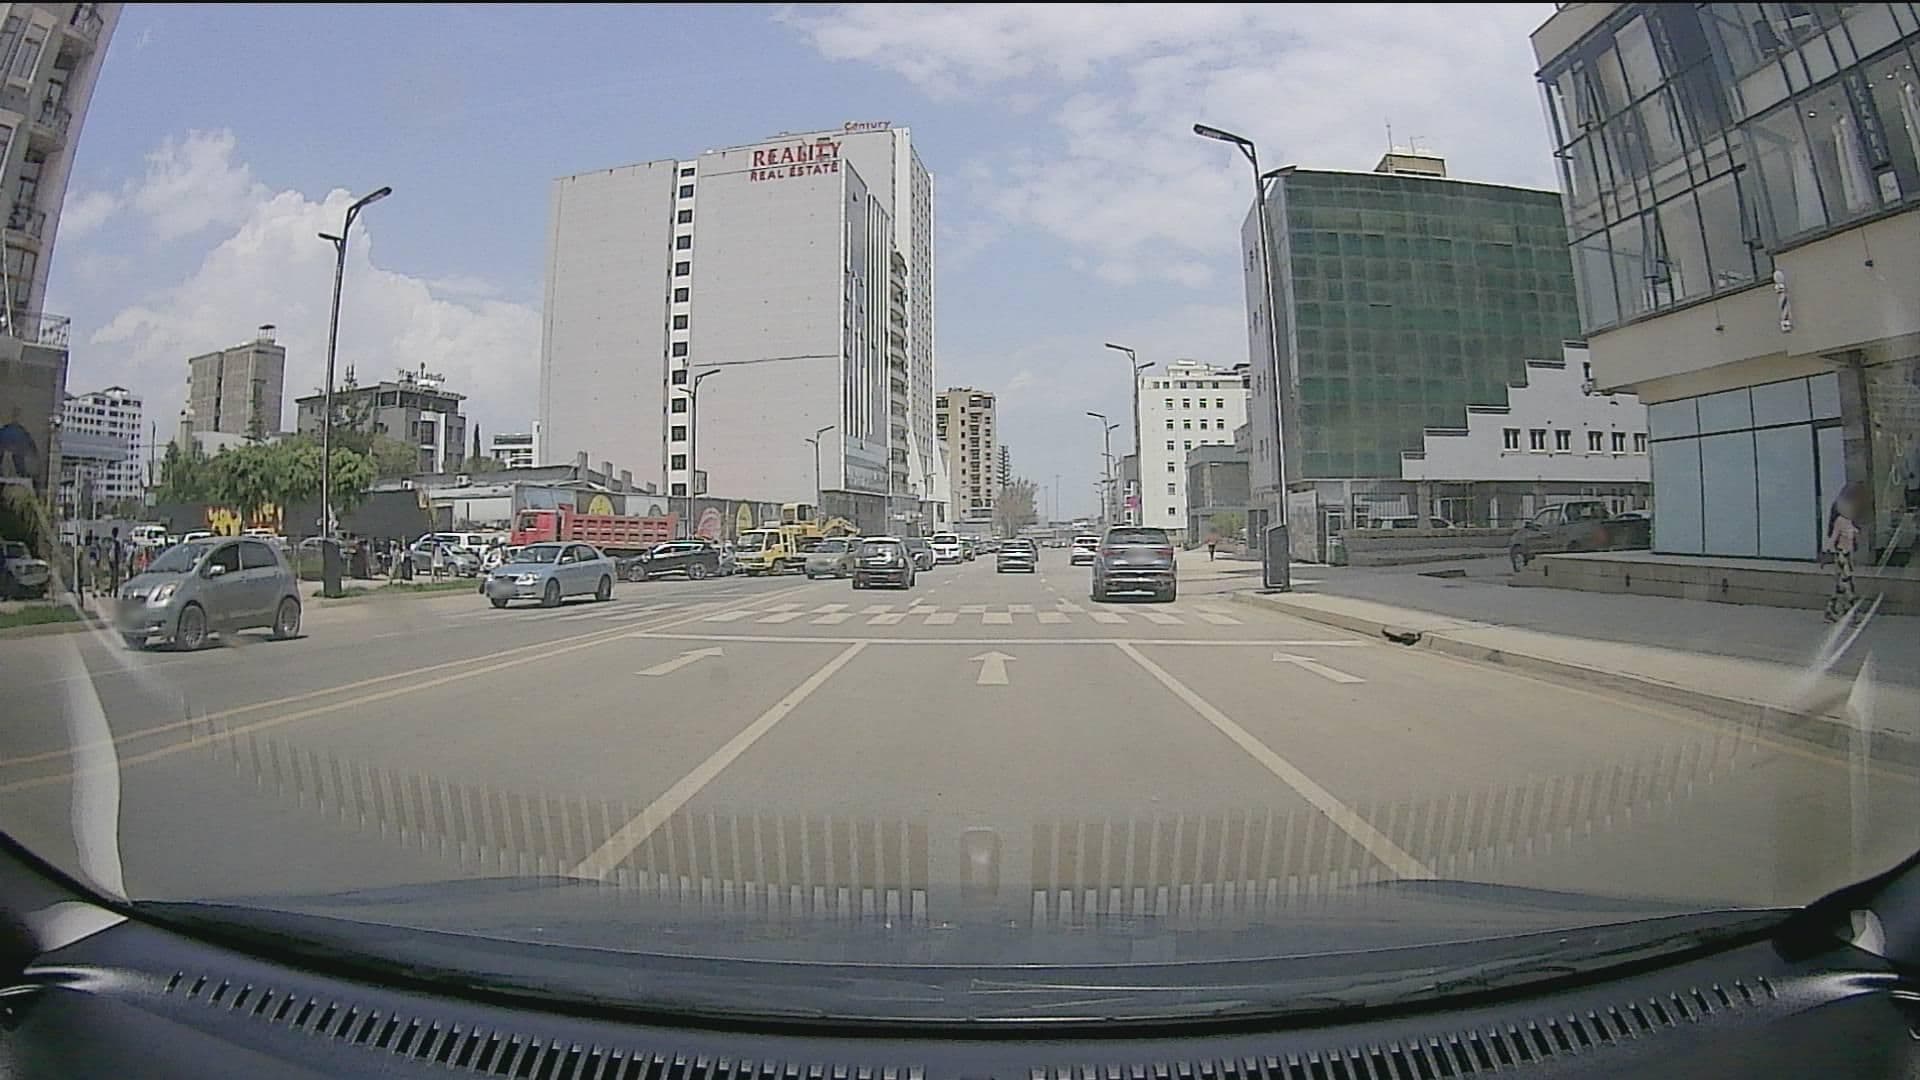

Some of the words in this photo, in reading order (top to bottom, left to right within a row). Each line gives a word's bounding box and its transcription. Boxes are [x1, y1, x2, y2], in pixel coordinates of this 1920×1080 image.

[753, 142, 841, 167] REALITY
[751, 169, 784, 182] REAL
[789, 161, 838, 177] ESTATE
